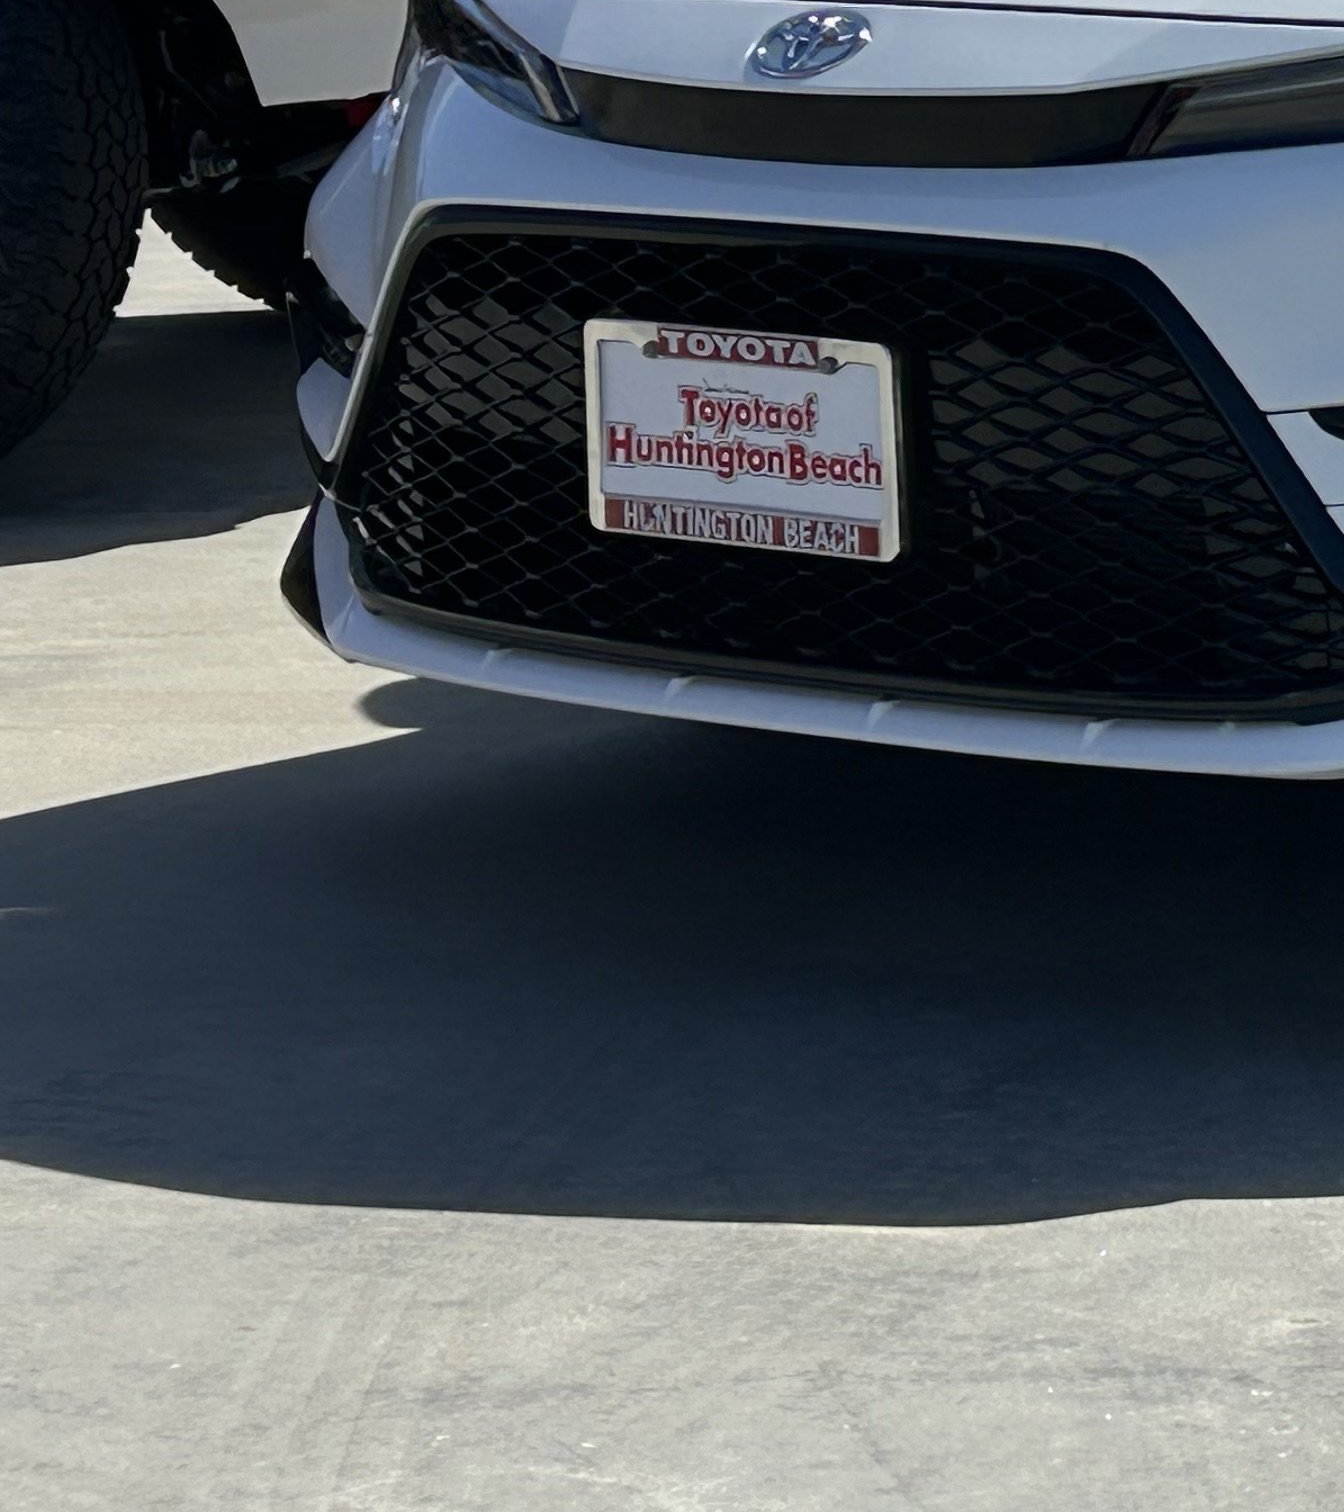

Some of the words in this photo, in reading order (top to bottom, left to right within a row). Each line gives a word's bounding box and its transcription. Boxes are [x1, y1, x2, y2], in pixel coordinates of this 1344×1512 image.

[661, 330, 817, 365] TOYOTA
[679, 387, 782, 436] Toyota
[784, 392, 819, 436] of
[608, 424, 785, 482] Huntington
[786, 439, 884, 489] Beach
[623, 500, 775, 546] HUNTINGTON
[783, 517, 860, 555] BEACH
